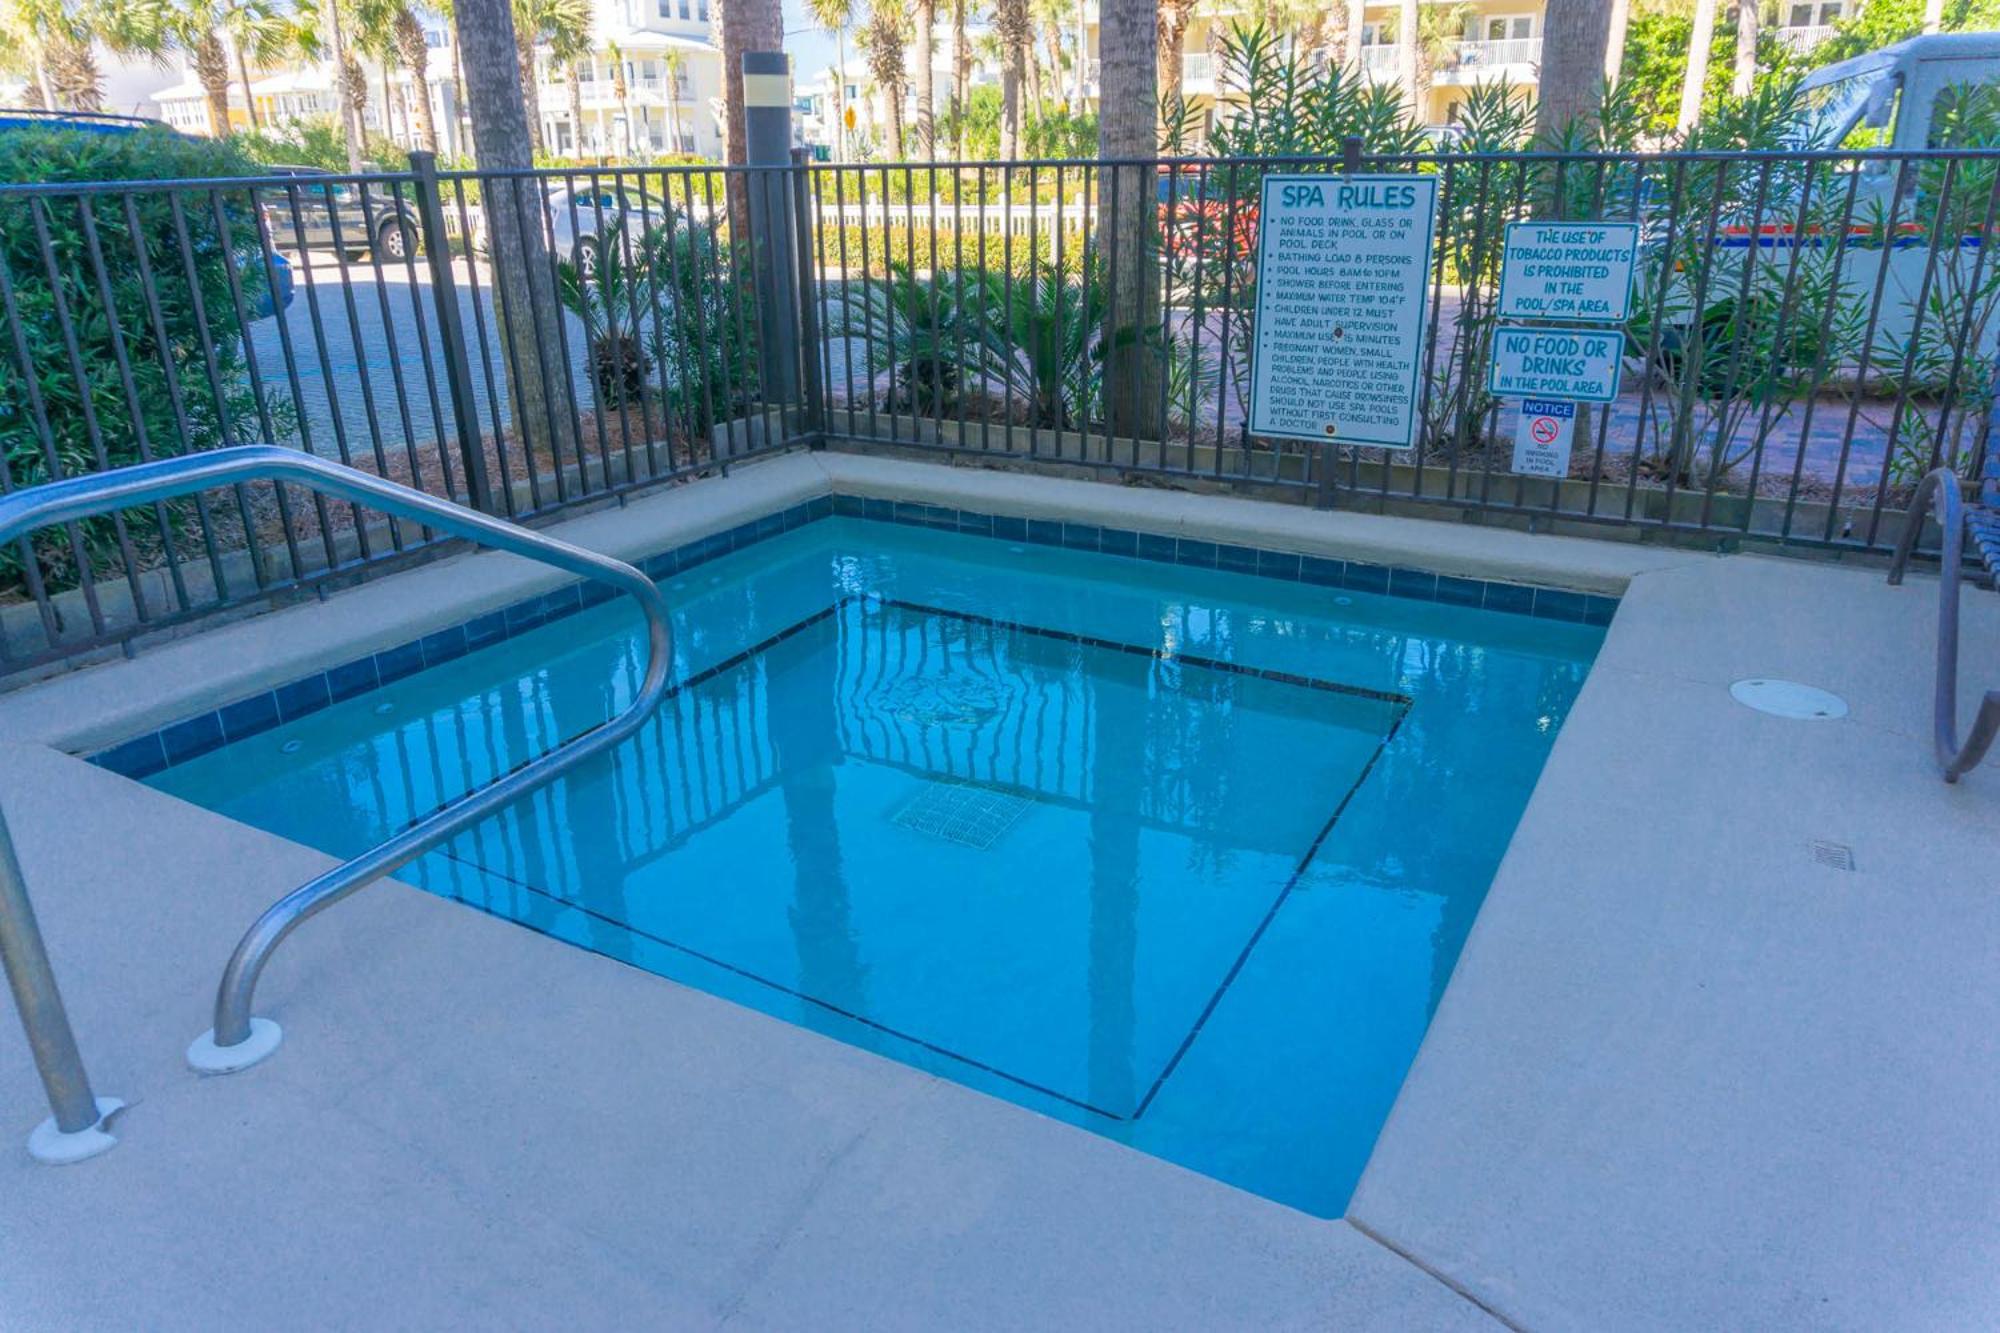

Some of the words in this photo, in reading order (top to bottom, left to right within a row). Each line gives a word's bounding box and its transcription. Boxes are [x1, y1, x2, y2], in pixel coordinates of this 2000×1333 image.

[1281, 185, 1325, 208] SPA
[1338, 185, 1417, 210] RULES
[1280, 216, 1295, 226] NO
[1298, 217, 1324, 226] FOOD
[1361, 217, 1395, 228] GLASS
[1399, 218, 1413, 229] OR
[1280, 229, 1324, 238] ANIMALS
[1328, 229, 1339, 238] IN
[1342, 229, 1367, 240] POOL
[1372, 230, 1386, 240] OR
[1390, 230, 1405, 240] ON
[1536, 231, 1559, 244] THE
[1561, 231, 1588, 244] USE
[1589, 232, 1606, 244] OF
[1279, 239, 1306, 249] POOL
[1312, 240, 1338, 250] DECK
[1278, 252, 1321, 262] BATHING
[1325, 254, 1351, 263] LOAD
[1366, 254, 1413, 265] PERSONS
[1510, 248, 1562, 262] TOBACCO
[1564, 249, 1630, 263] PRODUCTS
[1276, 266, 1300, 275] POOL
[1304, 266, 1334, 277] HOURS
[1375, 269, 1400, 278] 10PM
[1523, 265, 1536, 277] IS
[1537, 266, 1610, 279] PROHIBITED
[1277, 279, 1315, 288] SHOWER
[1318, 280, 1351, 290] BEFORE
[1355, 281, 1404, 292] ENTERING
[1544, 282, 1557, 295] IN
[1560, 282, 1585, 296] THE
[1276, 291, 1316, 300] MAXIMUM
[1319, 292, 1346, 302] WATER
[1274, 304, 1318, 314] CHILDREN
[1321, 306, 1350, 316] UNDER
[1353, 308, 1363, 317] 12
[1365, 308, 1395, 318] MUST
[1577, 300, 1610, 313] AREA
[1274, 317, 1296, 327] HAVE
[1300, 319, 1330, 328] ADULT
[1335, 320, 1398, 332] SUPERVISION
[1274, 330, 1316, 340] MAXIMUM
[1318, 332, 1334, 342] USE
[1355, 334, 1401, 345] MINUTES
[1273, 342, 1319, 353] PREGNANT
[1360, 346, 1393, 358] SMALL
[1506, 337, 1531, 354] NO
[1534, 338, 1580, 357] FOOD
[1583, 340, 1608, 359] OR
[1318, 357, 1350, 367] PEOPLE
[1353, 360, 1374, 369] WITH
[1375, 360, 1410, 370] HEALTH
[1522, 356, 1587, 377] DRINKS
[1271, 364, 1315, 375] PROBLEMS
[1317, 367, 1334, 376] AND
[1336, 369, 1367, 380] PEOPLE
[1370, 371, 1399, 382] USING
[1312, 378, 1359, 390] NARCOTICS
[1361, 382, 1374, 391] OR
[1375, 382, 1405, 394] OTHER
[1500, 377, 1512, 387] IN
[1515, 377, 1538, 390] THE
[1540, 379, 1570, 393] POOL
[1571, 381, 1604, 394] AREA
[1269, 385, 1297, 396] DRUGS
[1299, 387, 1322, 397] THAT
[1325, 389, 1352, 400] CAUSE
[1354, 392, 1409, 405] DROWSINESS
[1269, 396, 1305, 406] SHOULD
[1307, 399, 1325, 409] NOT
[1328, 401, 1345, 410] USE
[1349, 402, 1366, 412] SPA
[1369, 404, 1398, 415] POOLS
[1524, 402, 1573, 416] NOTICE
[1269, 407, 1309, 418] WITHOUT
[1311, 410, 1336, 421] FIRST
[1339, 412, 1400, 426] CONSULTING
[1269, 417, 1276, 425] A
[1279, 419, 1318, 430] DOCTOR
